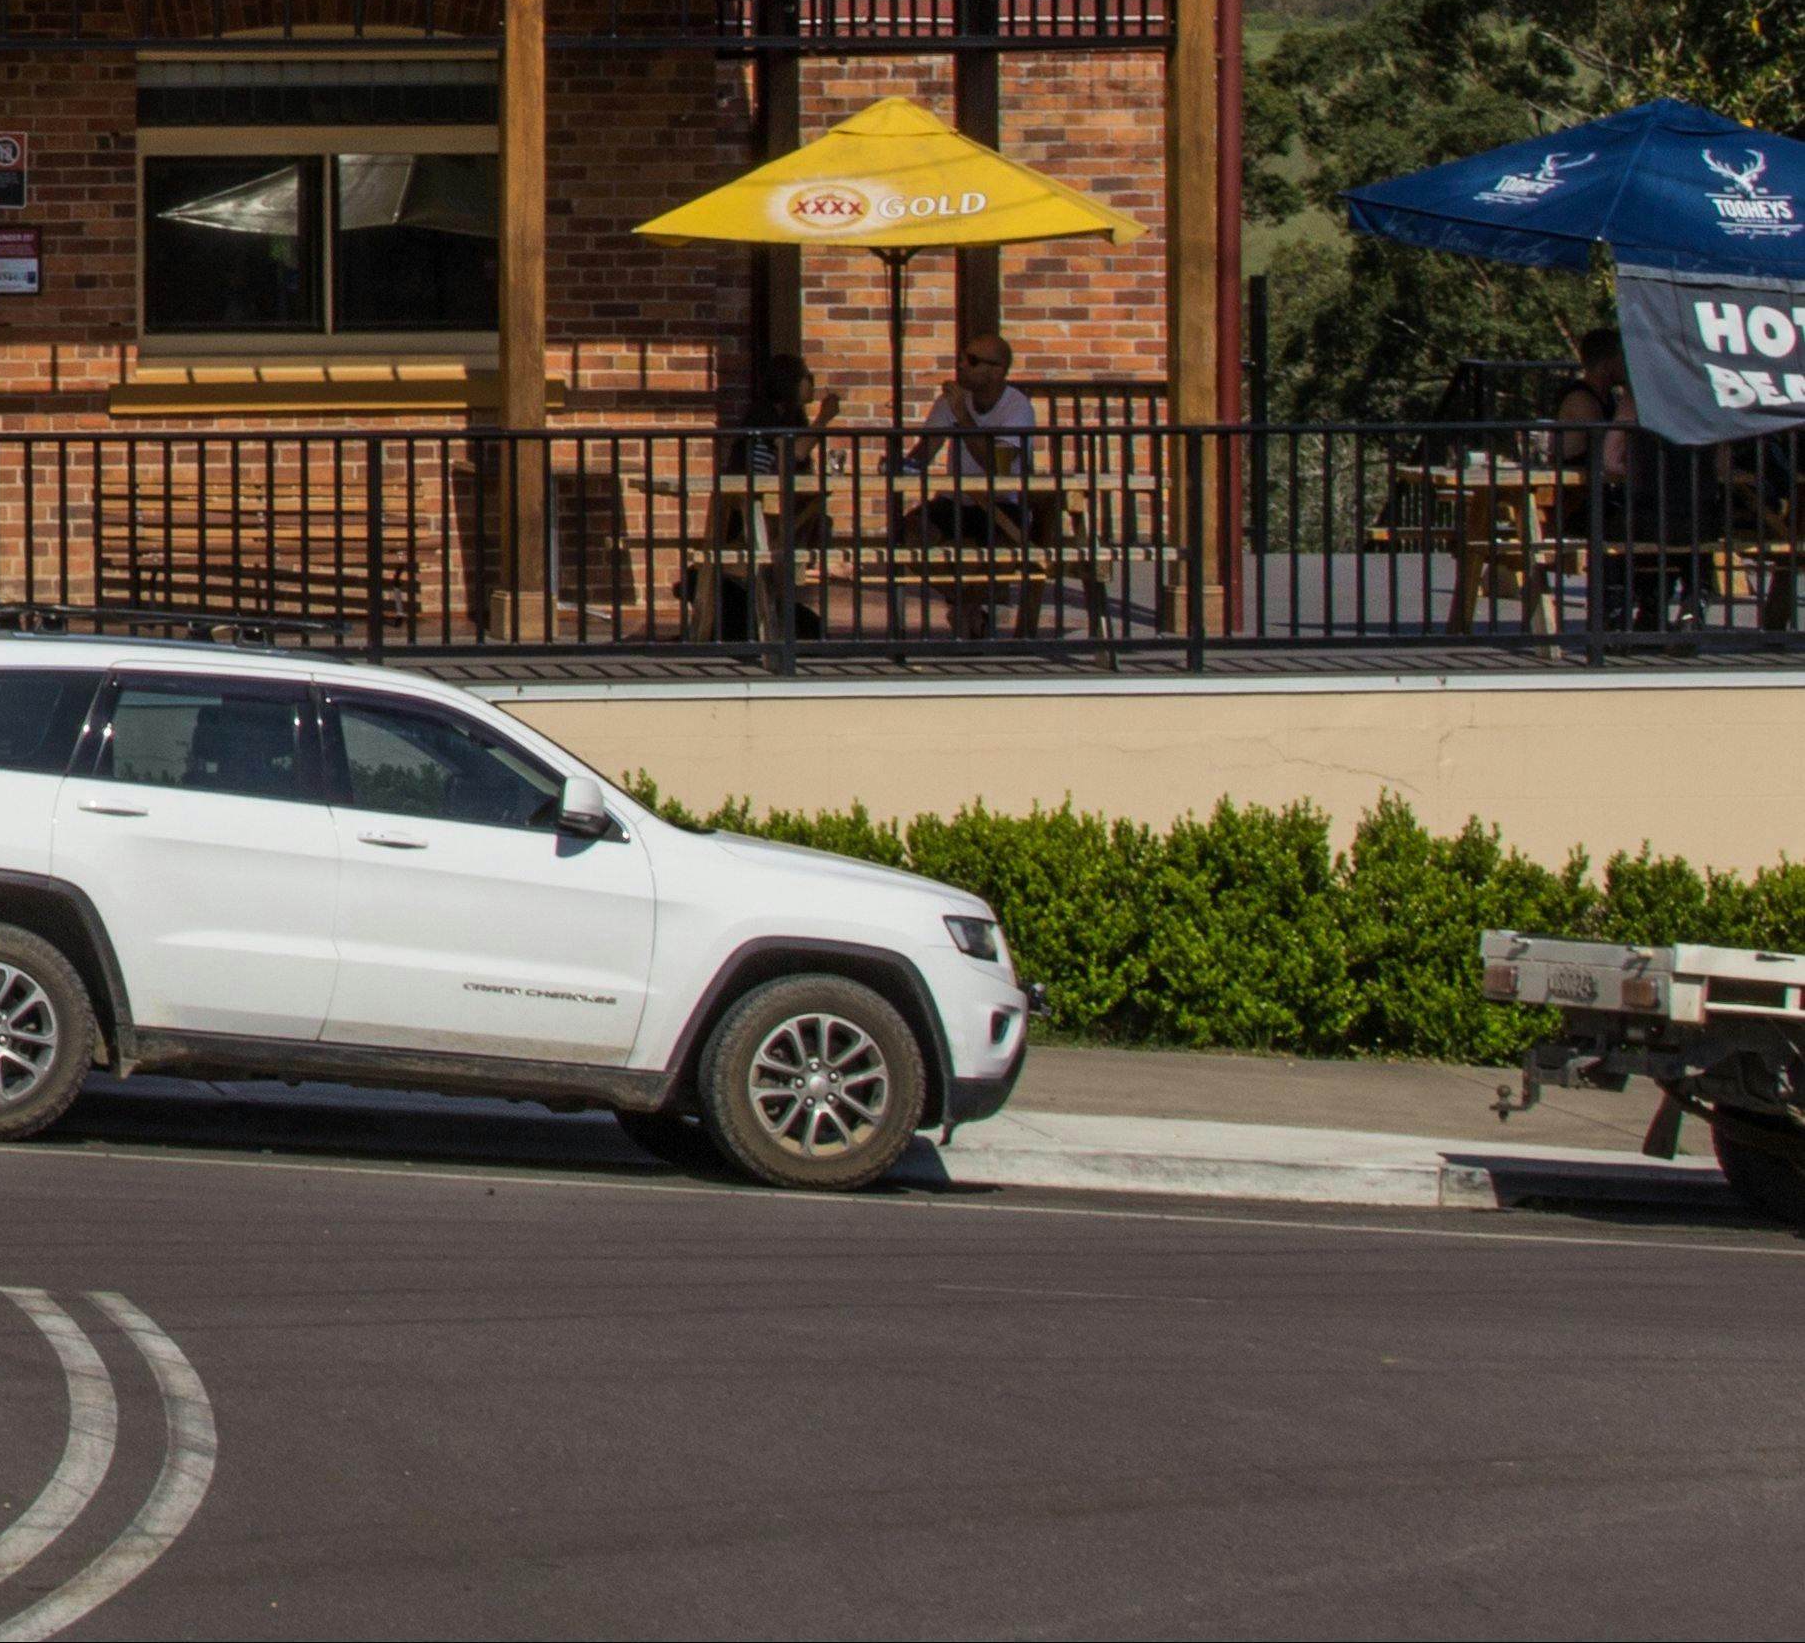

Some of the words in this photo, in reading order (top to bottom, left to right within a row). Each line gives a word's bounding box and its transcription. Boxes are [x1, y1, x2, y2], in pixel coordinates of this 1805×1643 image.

[794, 201, 864, 215] XXXX
[878, 193, 987, 219] GOLD
[1712, 199, 1794, 219] TOOHEYS
[463, 982, 521, 995] GRAND
[526, 988, 617, 1004] CHEROKEE
